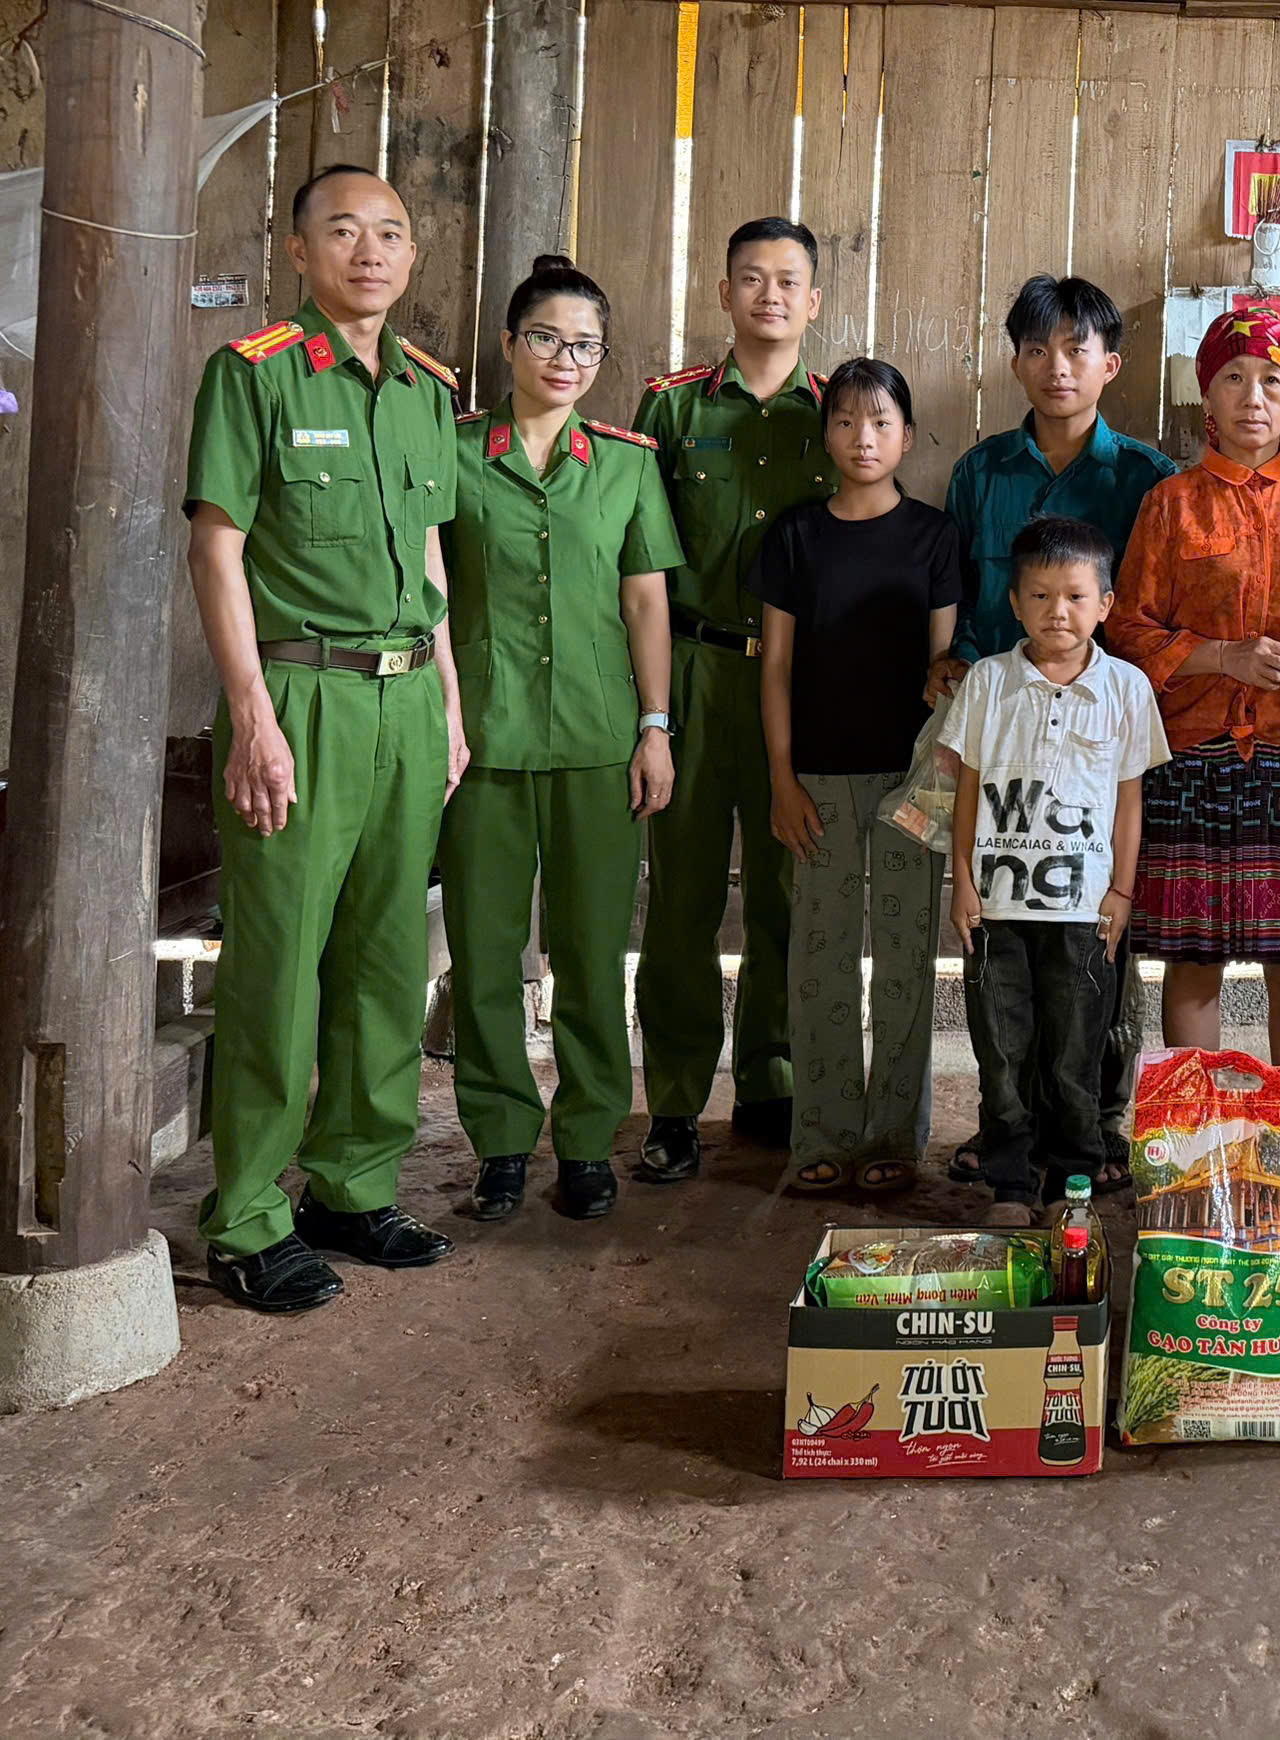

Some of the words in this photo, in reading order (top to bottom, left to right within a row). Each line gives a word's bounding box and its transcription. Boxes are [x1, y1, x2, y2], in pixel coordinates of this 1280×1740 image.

[977, 837, 1051, 850] LAEMCAIAG
[1056, 840, 1065, 851] &
[1070, 840, 1104, 853] WNAG
[884, 1291, 913, 1305] Minh
[1162, 1267, 1234, 1308] ST
[897, 1311, 994, 1335] CHIN-SU
[1196, 1314, 1240, 1334] Công
[1242, 1317, 1263, 1332] ty
[1148, 1330, 1193, 1353] GẠO
[1196, 1335, 1246, 1355] TÂN
[900, 1360, 944, 1396] TỎI
[951, 1359, 985, 1395] ỚT
[1047, 1364, 1081, 1373] CHIN-SU
[901, 1396, 988, 1439] TƯƠI
[827, 1457, 843, 1466] chai
[850, 1457, 864, 1466] 330
